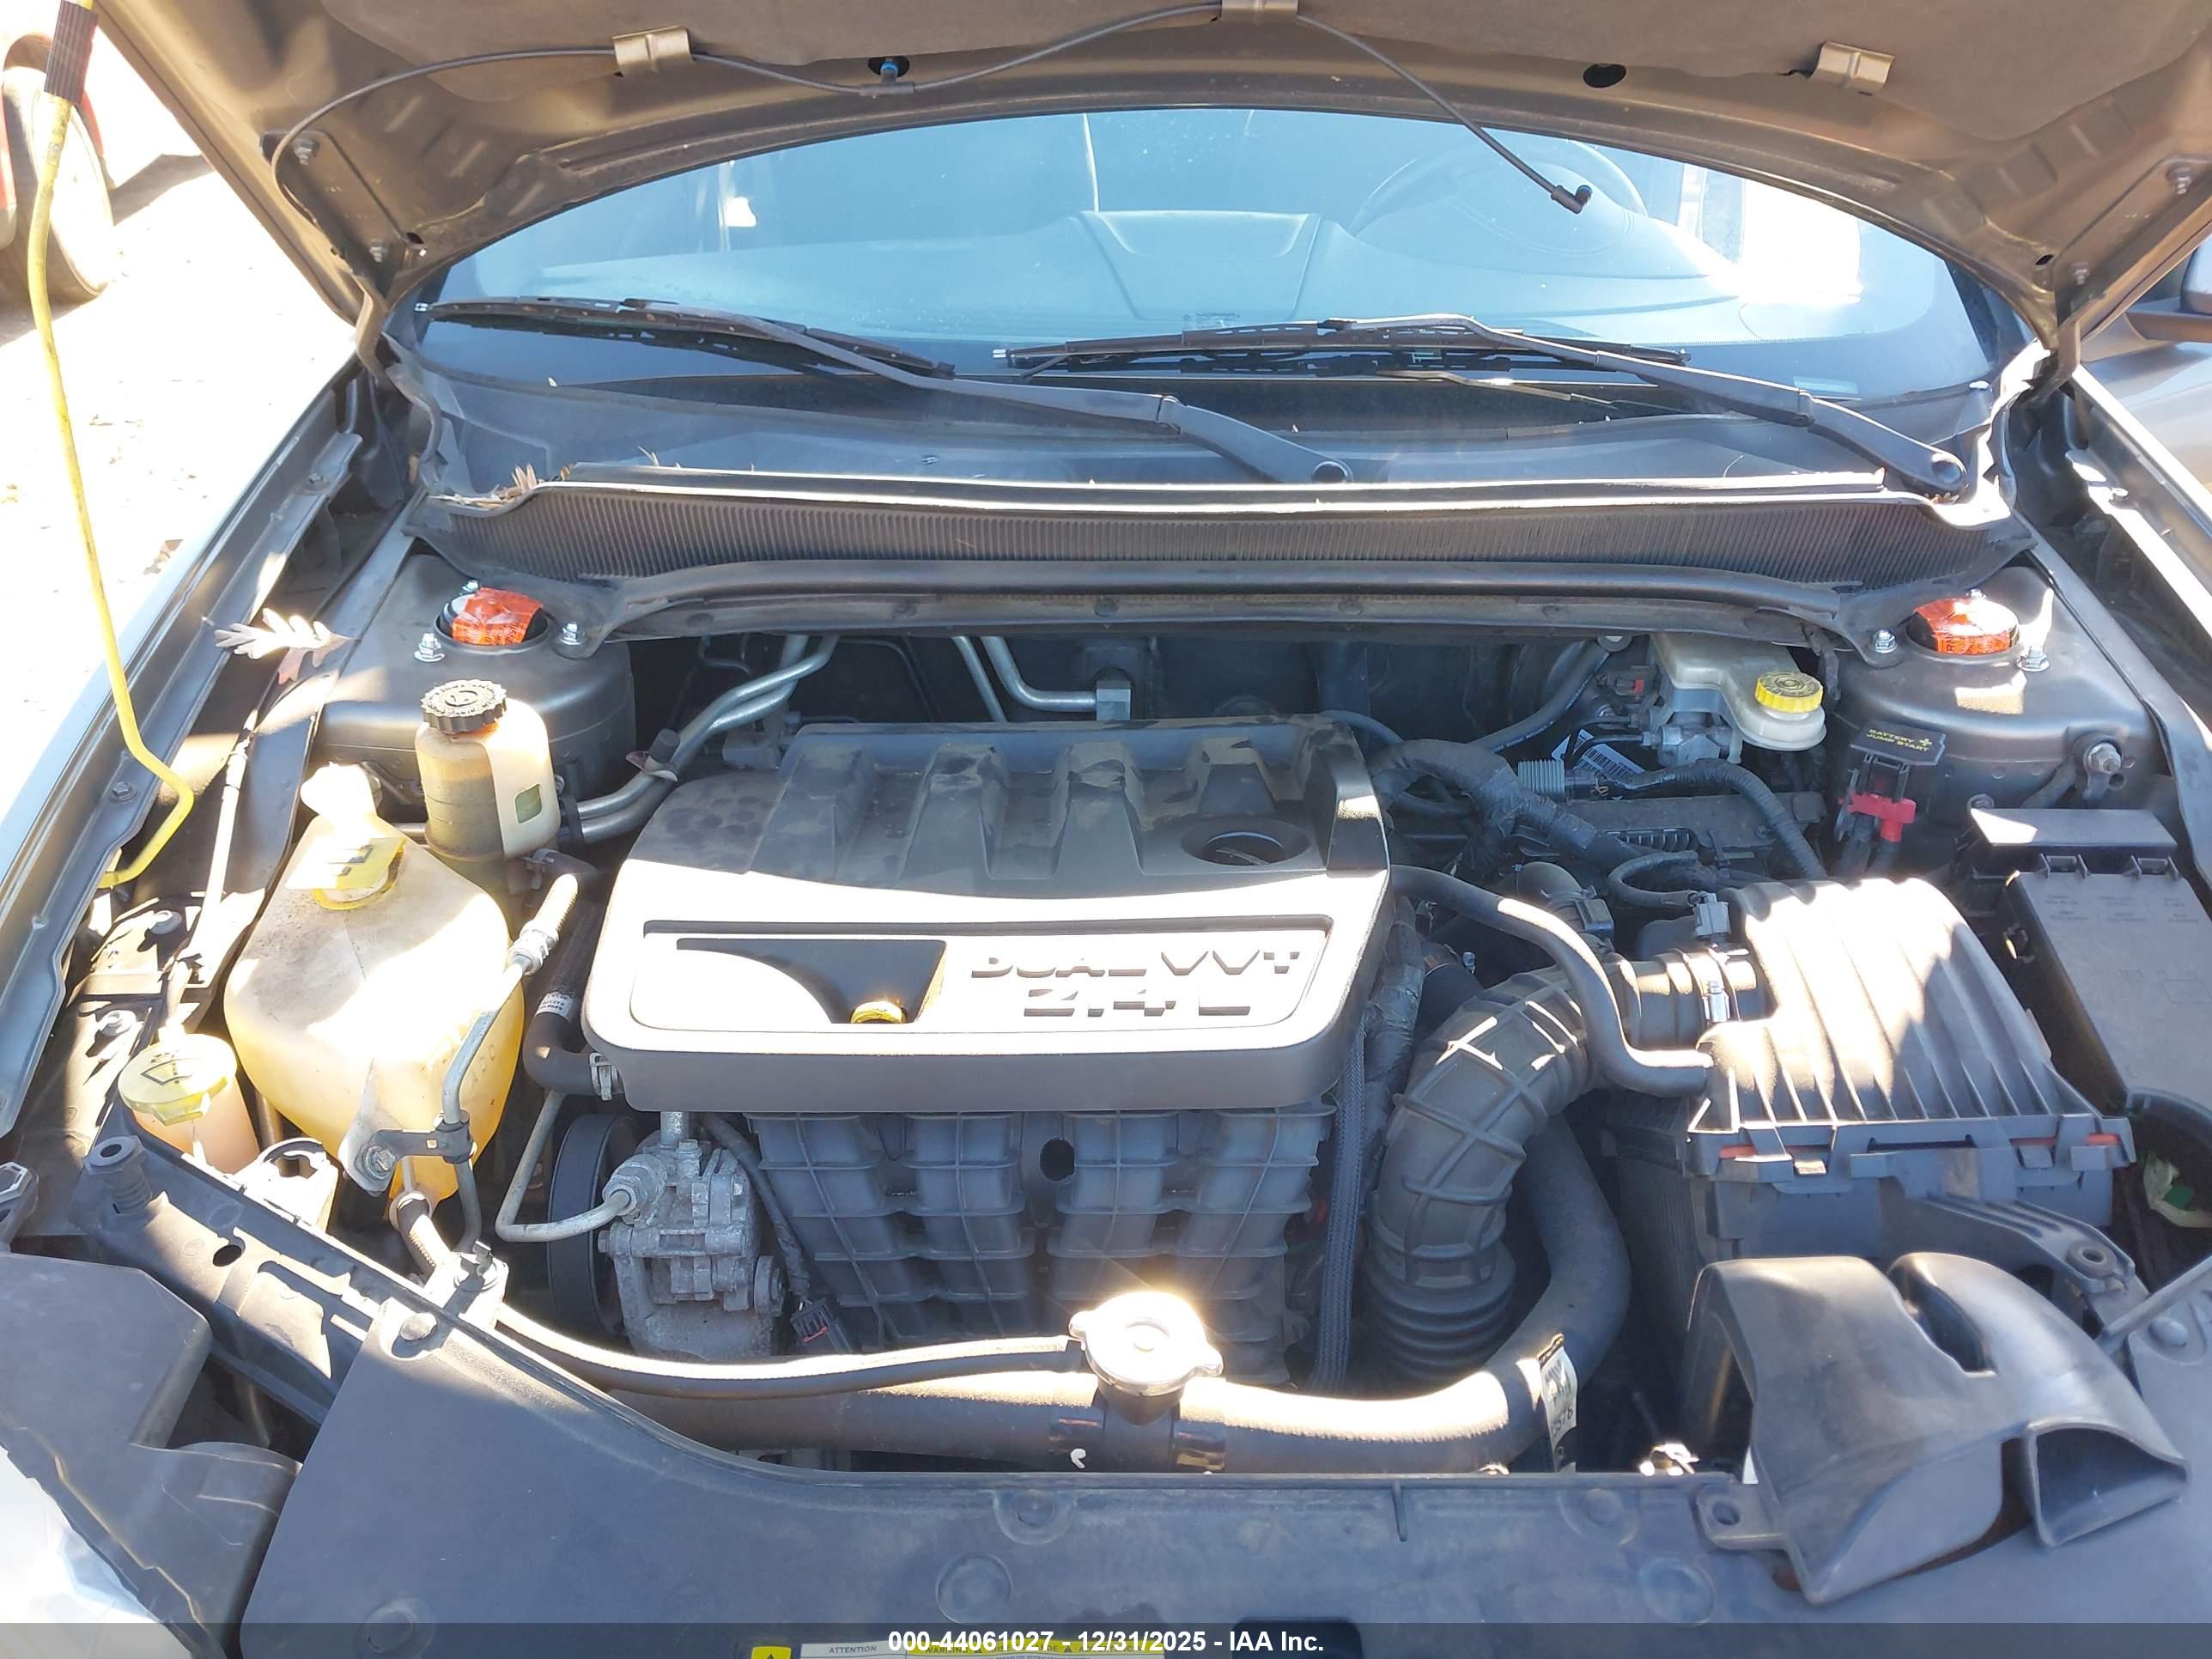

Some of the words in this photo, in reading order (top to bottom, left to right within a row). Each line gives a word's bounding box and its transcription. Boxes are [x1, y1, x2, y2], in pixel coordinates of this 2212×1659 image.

[1866, 732, 1895, 743] JUMP
[1896, 740, 1930, 752] START
[1869, 728, 1914, 744] BATTERY
[971, 954, 1147, 979] DUAL
[1160, 949, 1300, 977] VVT
[828, 1645, 878, 1654] ATTENTION
